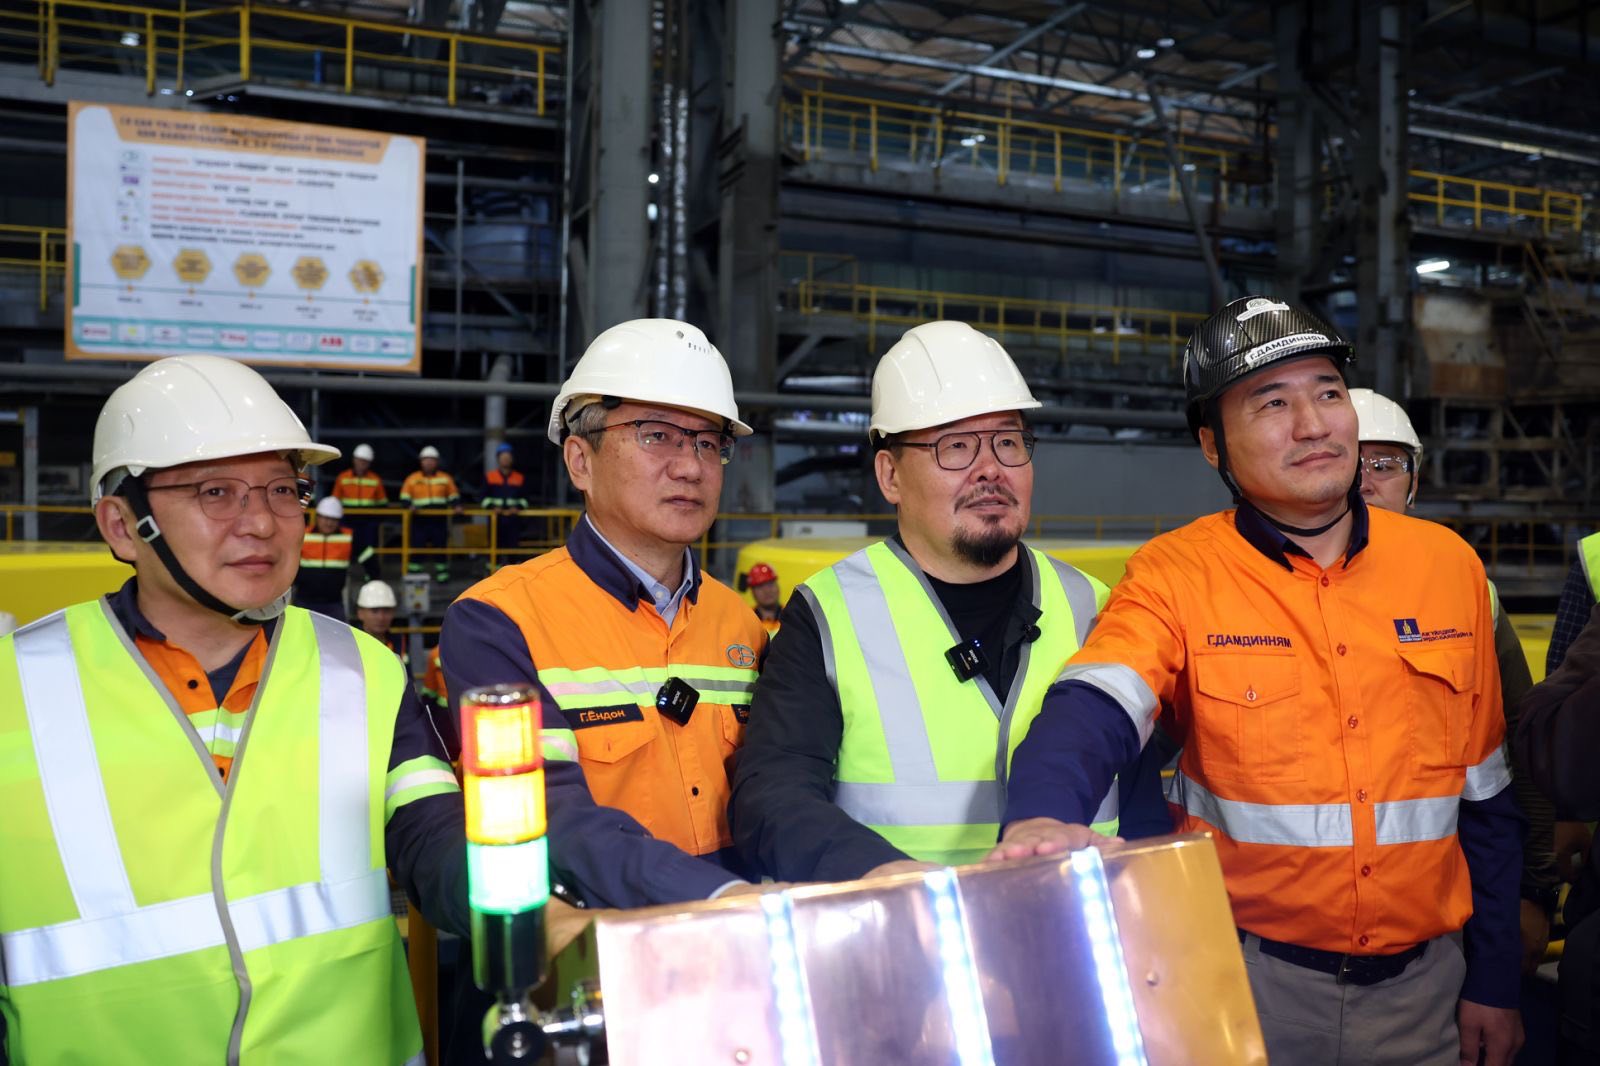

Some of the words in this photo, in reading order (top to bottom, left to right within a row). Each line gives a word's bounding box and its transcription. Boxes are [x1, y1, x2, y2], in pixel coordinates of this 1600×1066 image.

[320, 336, 343, 347] ABB
[1249, 335, 1325, 360] Г.ДАМДИННЯМ
[1207, 634, 1292, 648] Г.ДАМДИННЯМ
